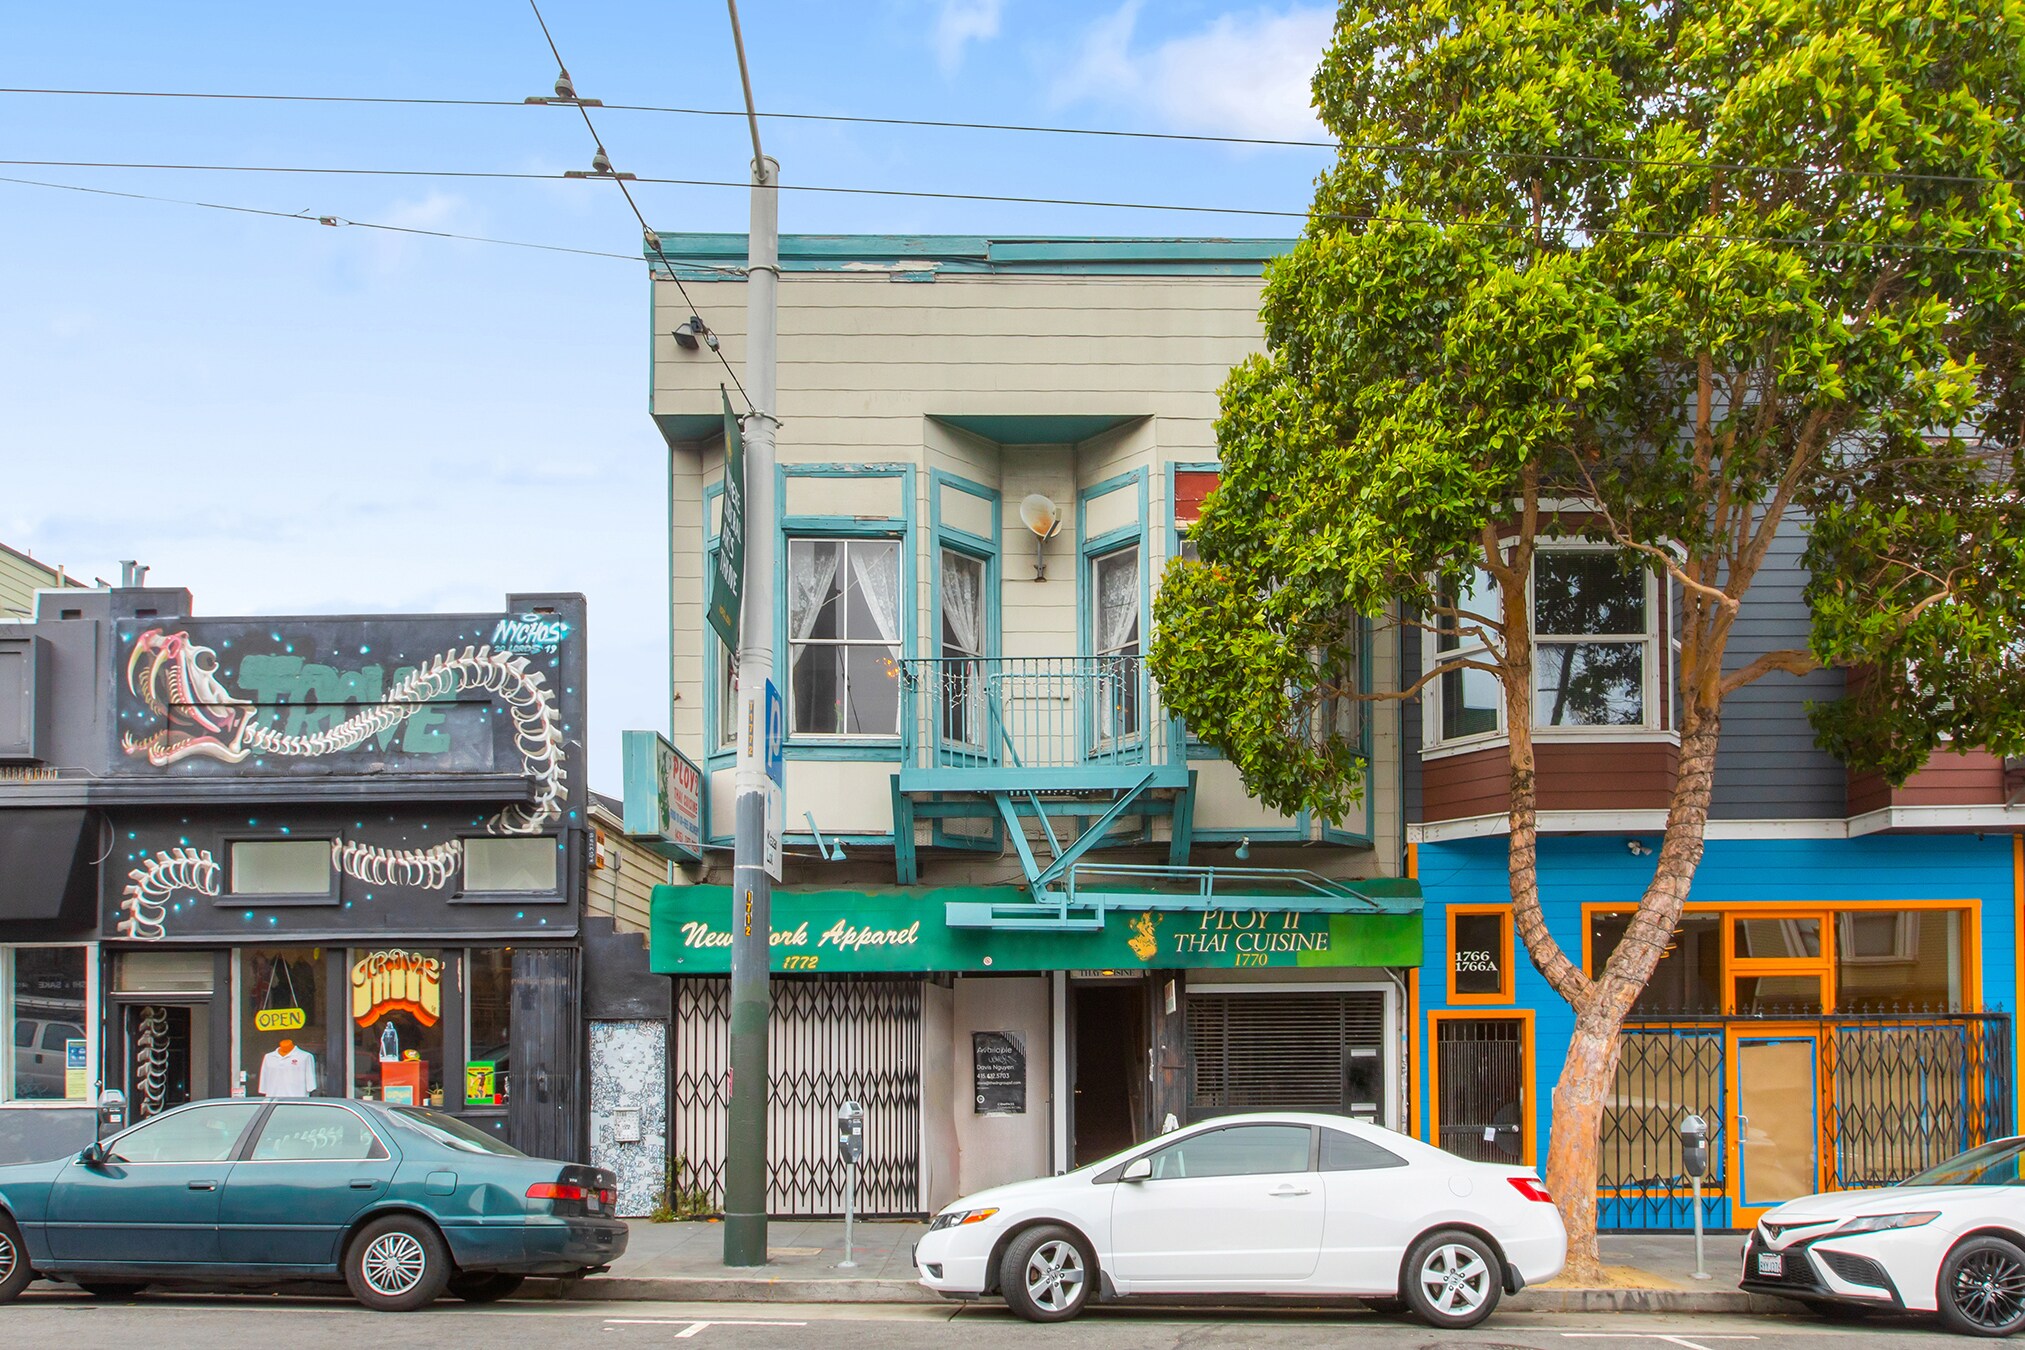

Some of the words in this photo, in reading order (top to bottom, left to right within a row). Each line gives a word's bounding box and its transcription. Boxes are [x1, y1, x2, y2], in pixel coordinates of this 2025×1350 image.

[492, 619, 567, 643] NYCHOS
[745, 890, 753, 937] 1712
[1199, 911, 1272, 930] PLOY
[681, 921, 733, 948] New
[769, 921, 809, 946] ork
[817, 918, 920, 951] Apparel
[1174, 933, 1228, 952] THAI
[1234, 932, 1329, 952] CUISINE
[782, 955, 819, 970] 1772
[1235, 953, 1268, 967] 1770
[1455, 951, 1490, 961] 1766
[1455, 961, 1499, 972] 1766A
[258, 1011, 301, 1027] OPEN
